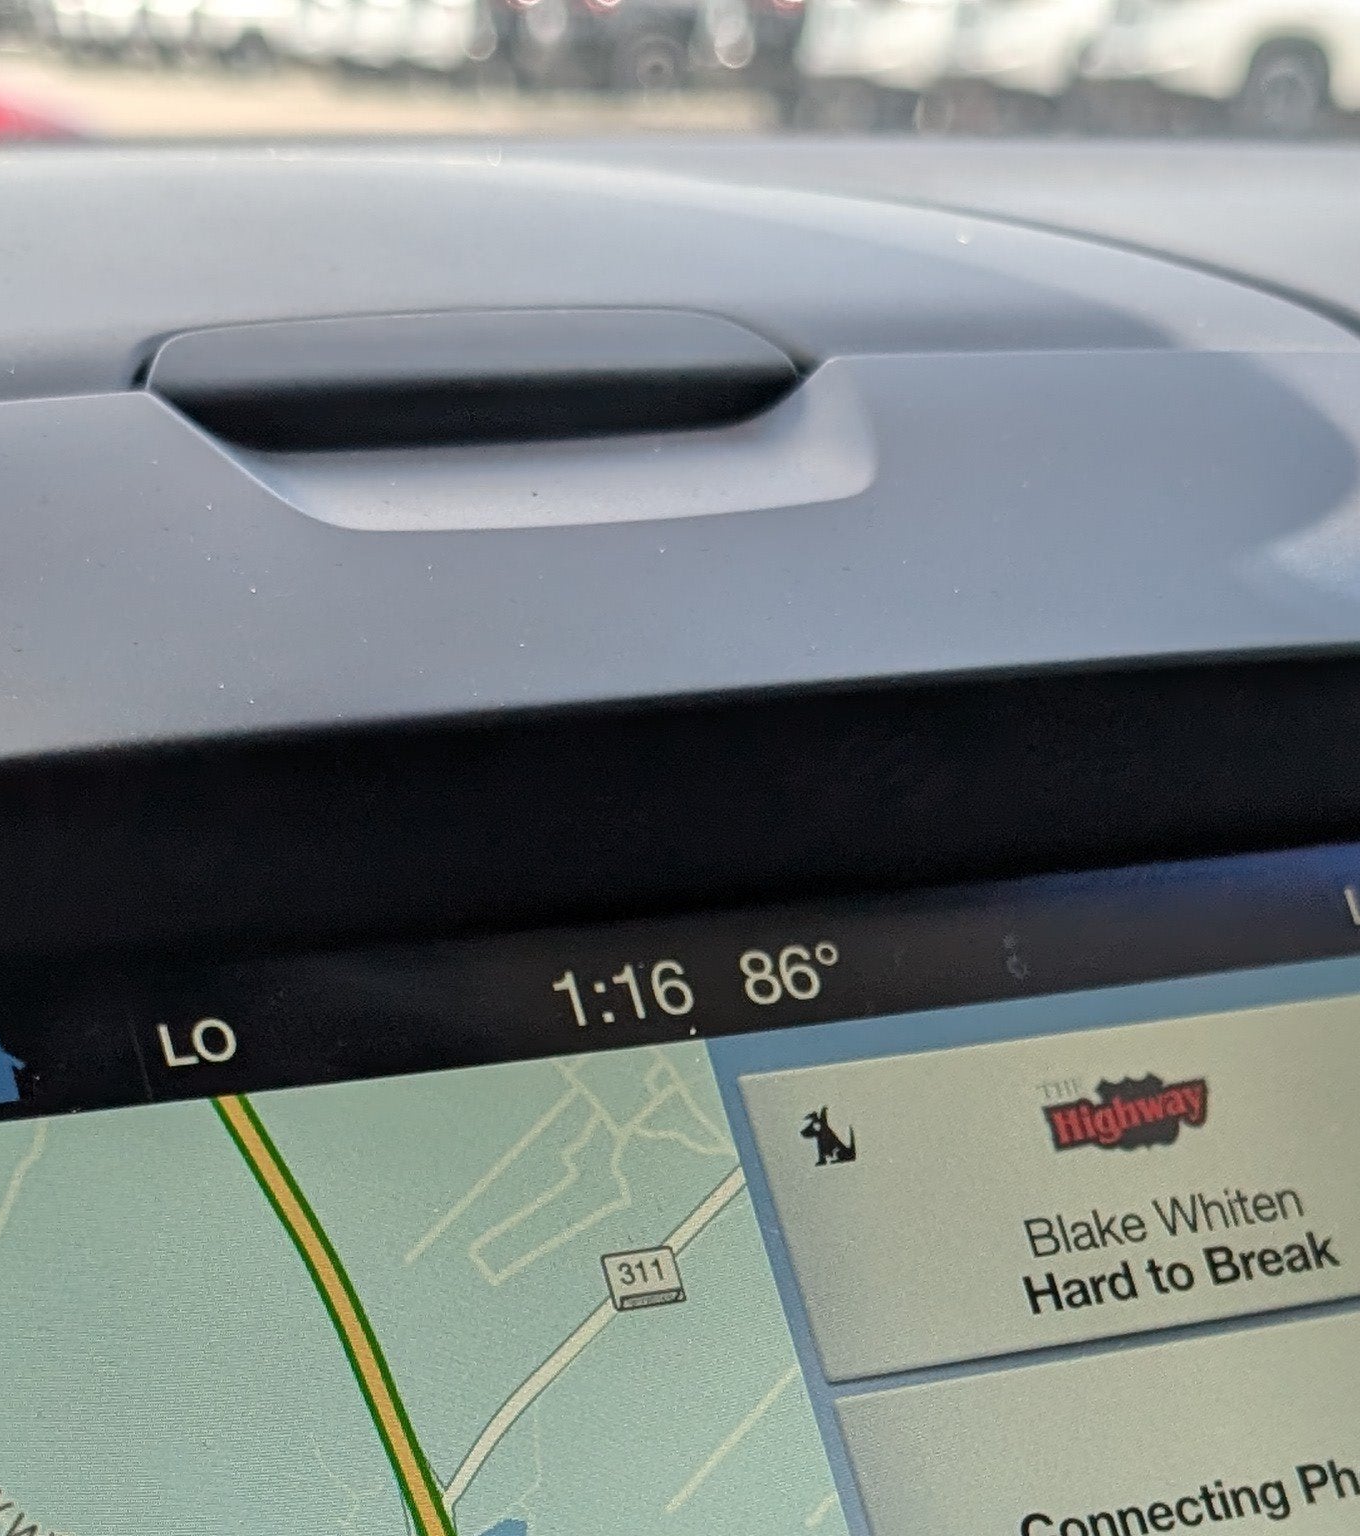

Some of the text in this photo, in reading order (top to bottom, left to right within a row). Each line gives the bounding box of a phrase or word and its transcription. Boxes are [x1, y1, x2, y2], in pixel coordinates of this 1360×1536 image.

[553, 959, 695, 1029] 1:16
[740, 942, 839, 1007] 86°
[158, 1019, 237, 1069] LO
[1048, 1085, 1206, 1146] Highway
[1023, 1184, 1305, 1258] Blake Whiten
[617, 1258, 664, 1285] 311
[1023, 1231, 1340, 1316] Hard to Break
